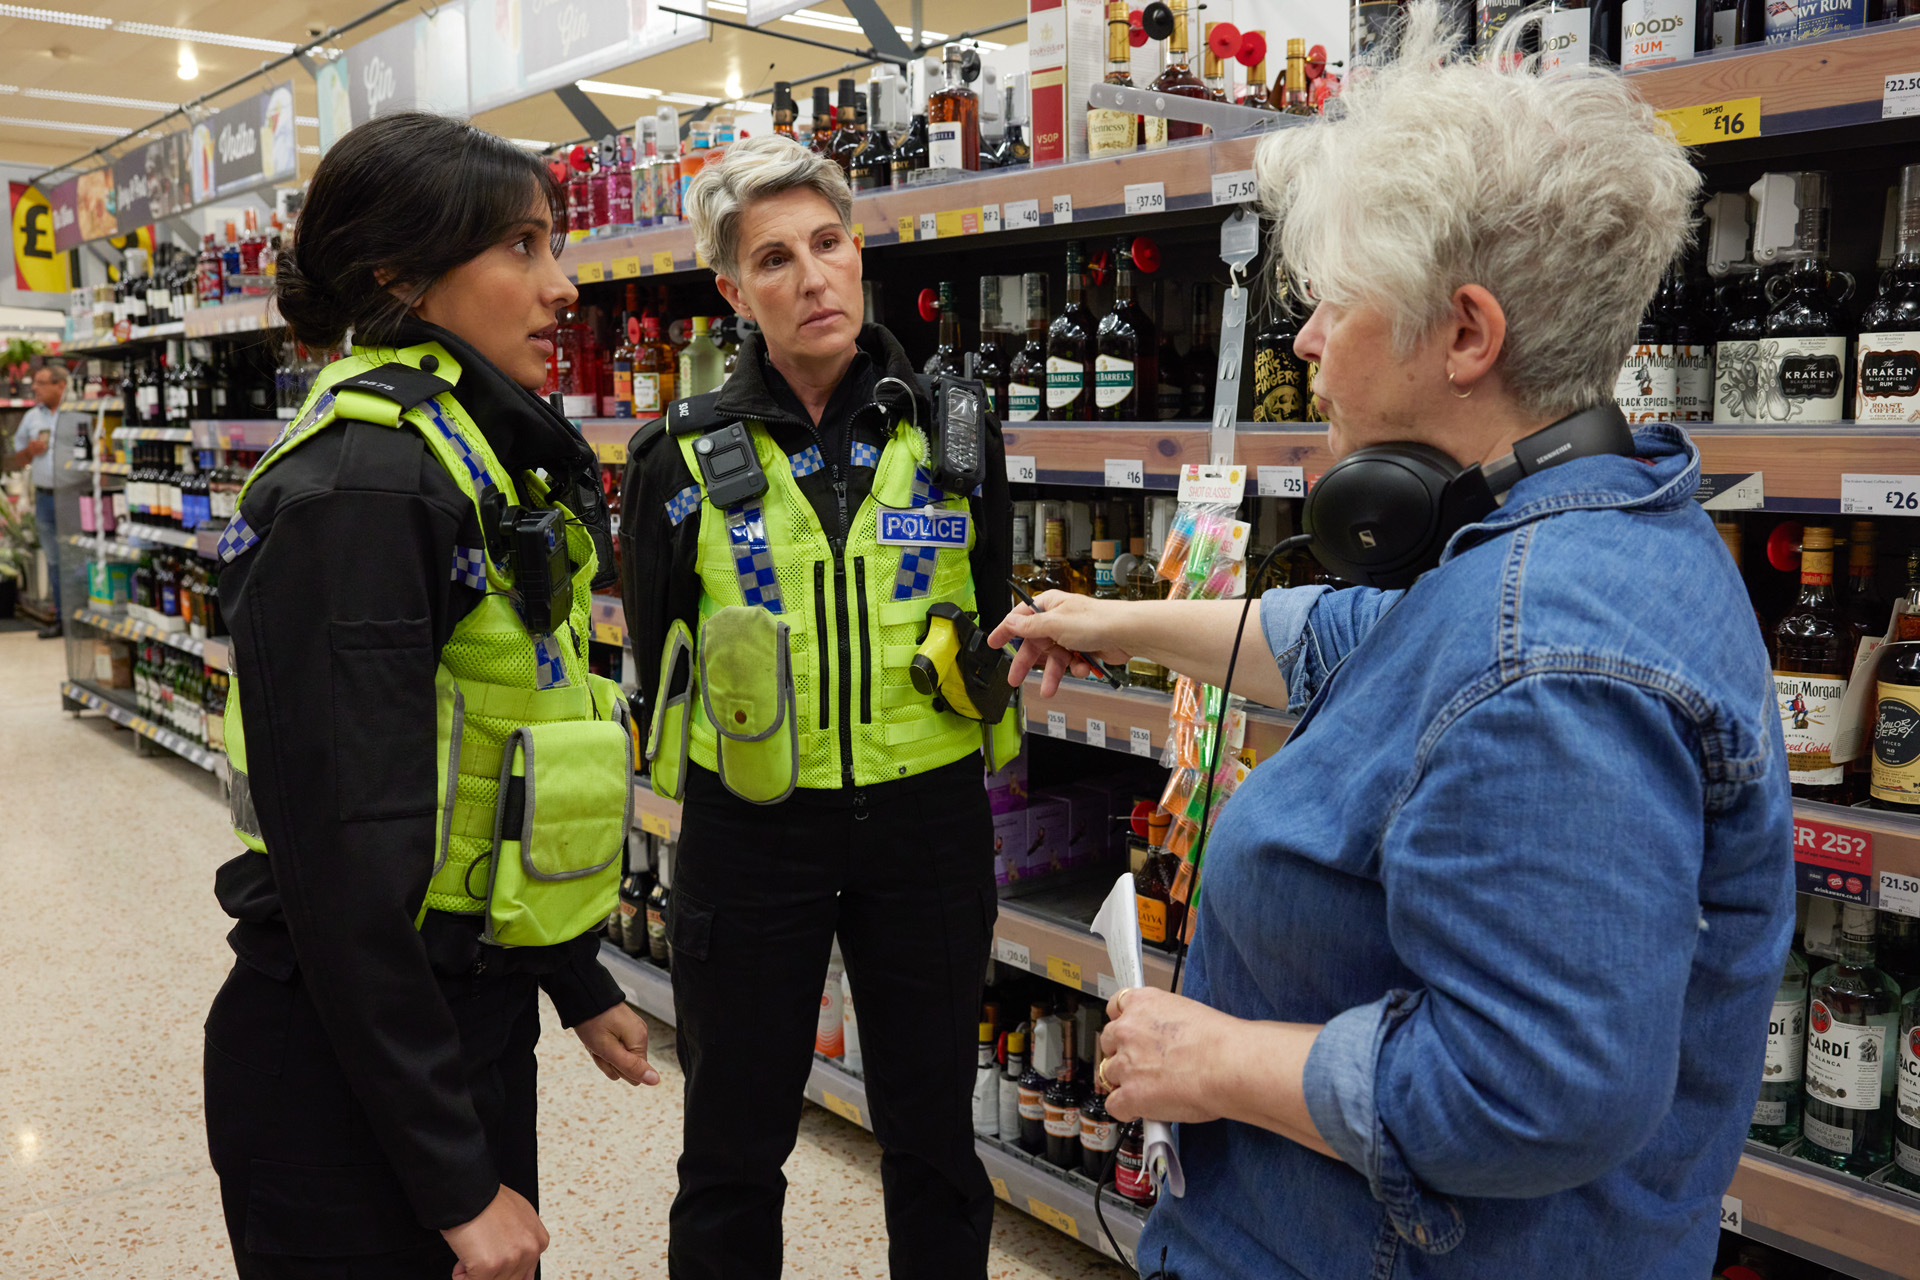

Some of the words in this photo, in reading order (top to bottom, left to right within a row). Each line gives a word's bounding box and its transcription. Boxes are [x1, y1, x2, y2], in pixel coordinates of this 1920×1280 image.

[557, 7, 591, 57] Gin
[1624, 15, 1684, 40] WOOD's
[363, 56, 396, 119] Gin
[1090, 121, 1127, 136] Hennessy
[1714, 112, 1746, 135] £16
[1037, 133, 1059, 144] VSOP
[1228, 181, 1255, 198] £7.50
[1054, 203, 1063, 213] RF
[1065, 202, 1070, 212] 2
[984, 212, 992, 221] RF
[994, 211, 998, 220] 2
[1023, 209, 1037, 222] £40
[21, 205, 52, 260] £
[1050, 374, 1080, 383] BARRELS
[1100, 373, 1130, 382] BARRELS
[1785, 371, 1834, 379] KRAKEN
[1866, 368, 1914, 376] KRAKEN
[1256, 371, 1300, 396] FINGERS
[1644, 397, 1668, 407] SPICED
[1536, 443, 1572, 464] SENNHEISER
[1019, 467, 1033, 479] £26
[1127, 471, 1141, 484] £16
[1188, 486, 1206, 498] SHOT
[1205, 487, 1231, 499] GLASSES
[1284, 478, 1301, 492] £25
[1886, 491, 1919, 510] £26
[887, 516, 963, 539] POLICE
[1776, 680, 1798, 695] ptain
[1800, 681, 1842, 700] Morgan
[1805, 742, 1831, 753] Gold
[1239, 757, 1252, 770] 18
[1821, 832, 1867, 857] 25?
[1881, 876, 1919, 893] £21.50
[1814, 886, 1862, 901] drinkaware.co.uk
[1810, 1032, 1850, 1059] CARDÍ
[1815, 1053, 1841, 1068] BLANCA
[1721, 1207, 1738, 1226] 24
